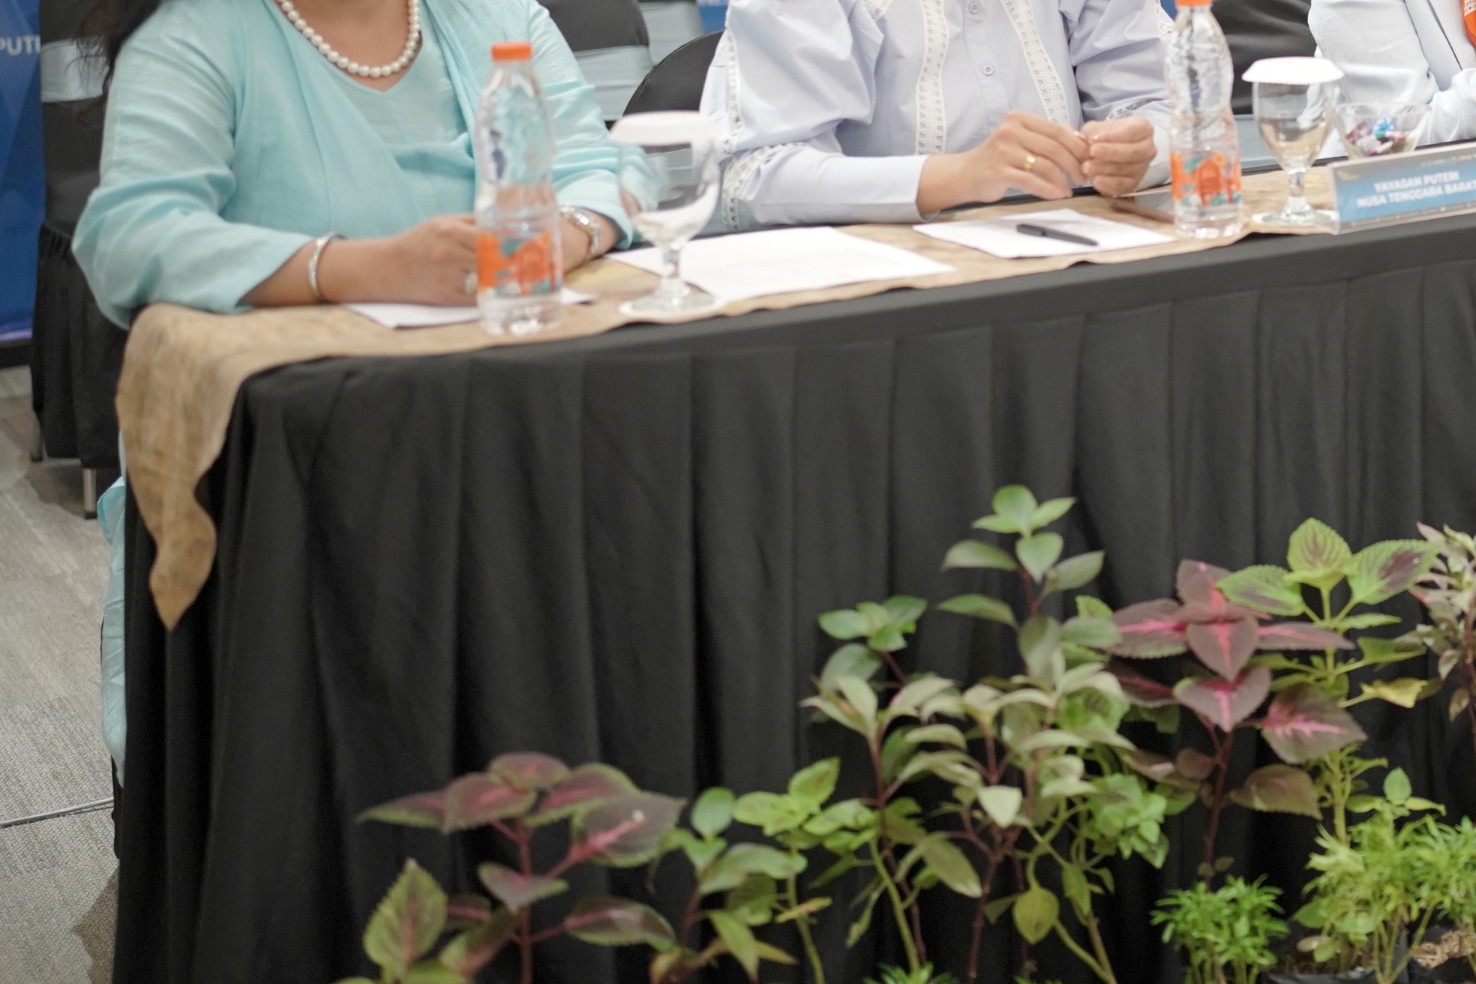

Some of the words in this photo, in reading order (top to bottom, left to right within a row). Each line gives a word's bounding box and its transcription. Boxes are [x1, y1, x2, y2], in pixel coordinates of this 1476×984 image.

[1374, 176, 1422, 193] YAYASAN
[1423, 170, 1459, 185] PUTERI
[1357, 194, 1388, 208] NUSA
[1387, 185, 1444, 203] TENGGARA
